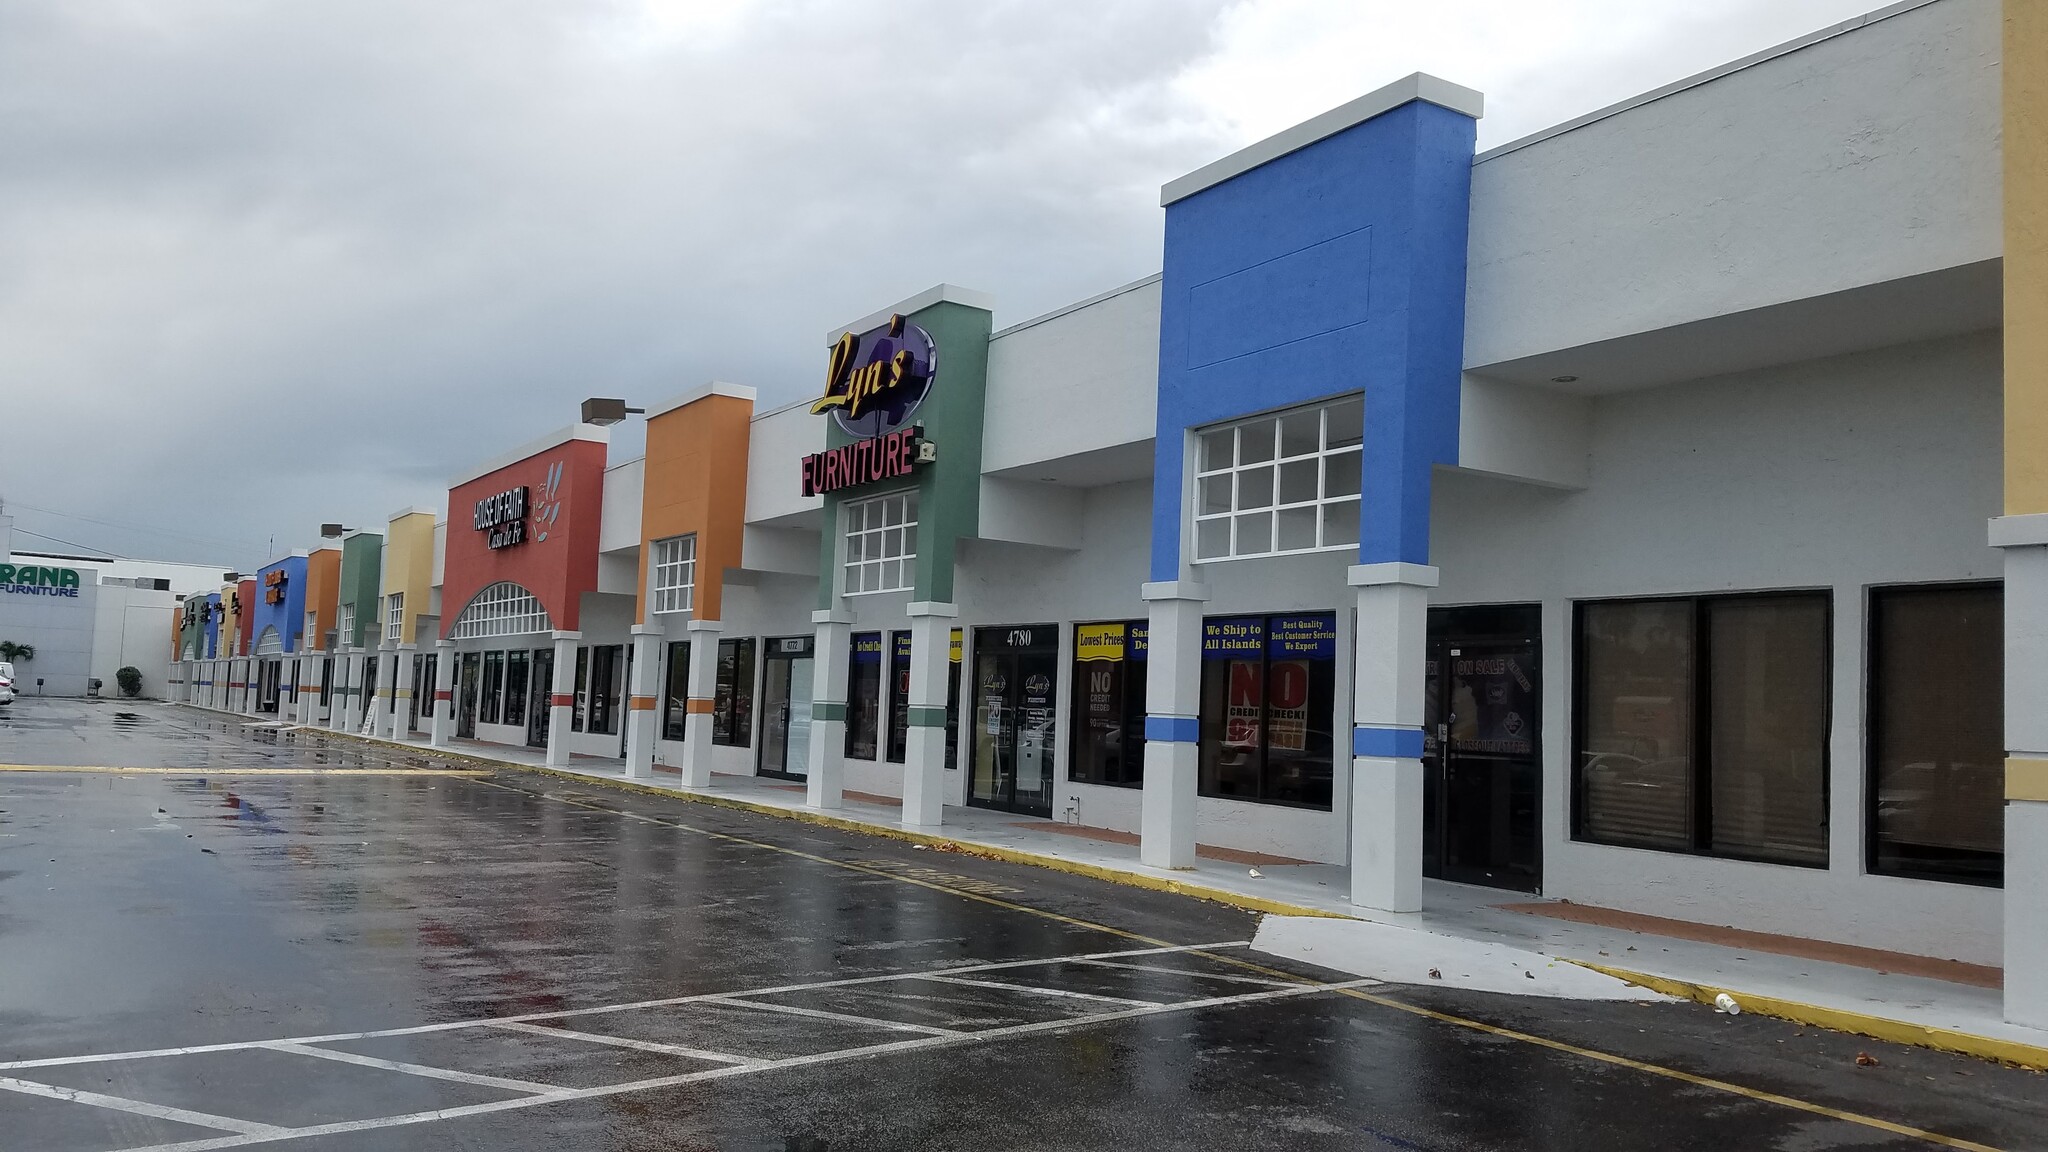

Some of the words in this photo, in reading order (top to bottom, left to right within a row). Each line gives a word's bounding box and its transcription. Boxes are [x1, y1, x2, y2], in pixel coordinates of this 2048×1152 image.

[809, 313, 906, 419] Lyn's
[801, 427, 915, 497] FURNITURE
[473, 496, 495, 531] HOUSE
[494, 492, 505, 525] OF
[503, 486, 524, 522] FAITH
[487, 528, 503, 550] Casa
[503, 524, 512, 546] de
[511, 521, 522, 544] Fe
[1206, 625, 1221, 636] We
[1223, 624, 1247, 638] Ship
[1249, 624, 1262, 635] to
[1282, 621, 1297, 630] Best
[1298, 620, 1324, 631] Quality
[1006, 629, 1032, 647] 4780
[1079, 633, 1103, 647] Lowest
[1103, 632, 1125, 646] Prices
[1271, 631, 1284, 640] Best
[1284, 631, 1312, 640] Customer
[1312, 630, 1335, 640] Service
[1204, 639, 1220, 650] All
[1221, 638, 1262, 650] Islands
[1284, 642, 1294, 650] We
[1295, 641, 1318, 652] Export
[1474, 659, 1505, 675] SALE
[1090, 671, 1112, 693] NO
[1230, 662, 1307, 709] NO
[1090, 693, 1111, 703] CREDIT
[1089, 703, 1111, 712] NEEDED
[1230, 707, 1262, 717] CREDI
